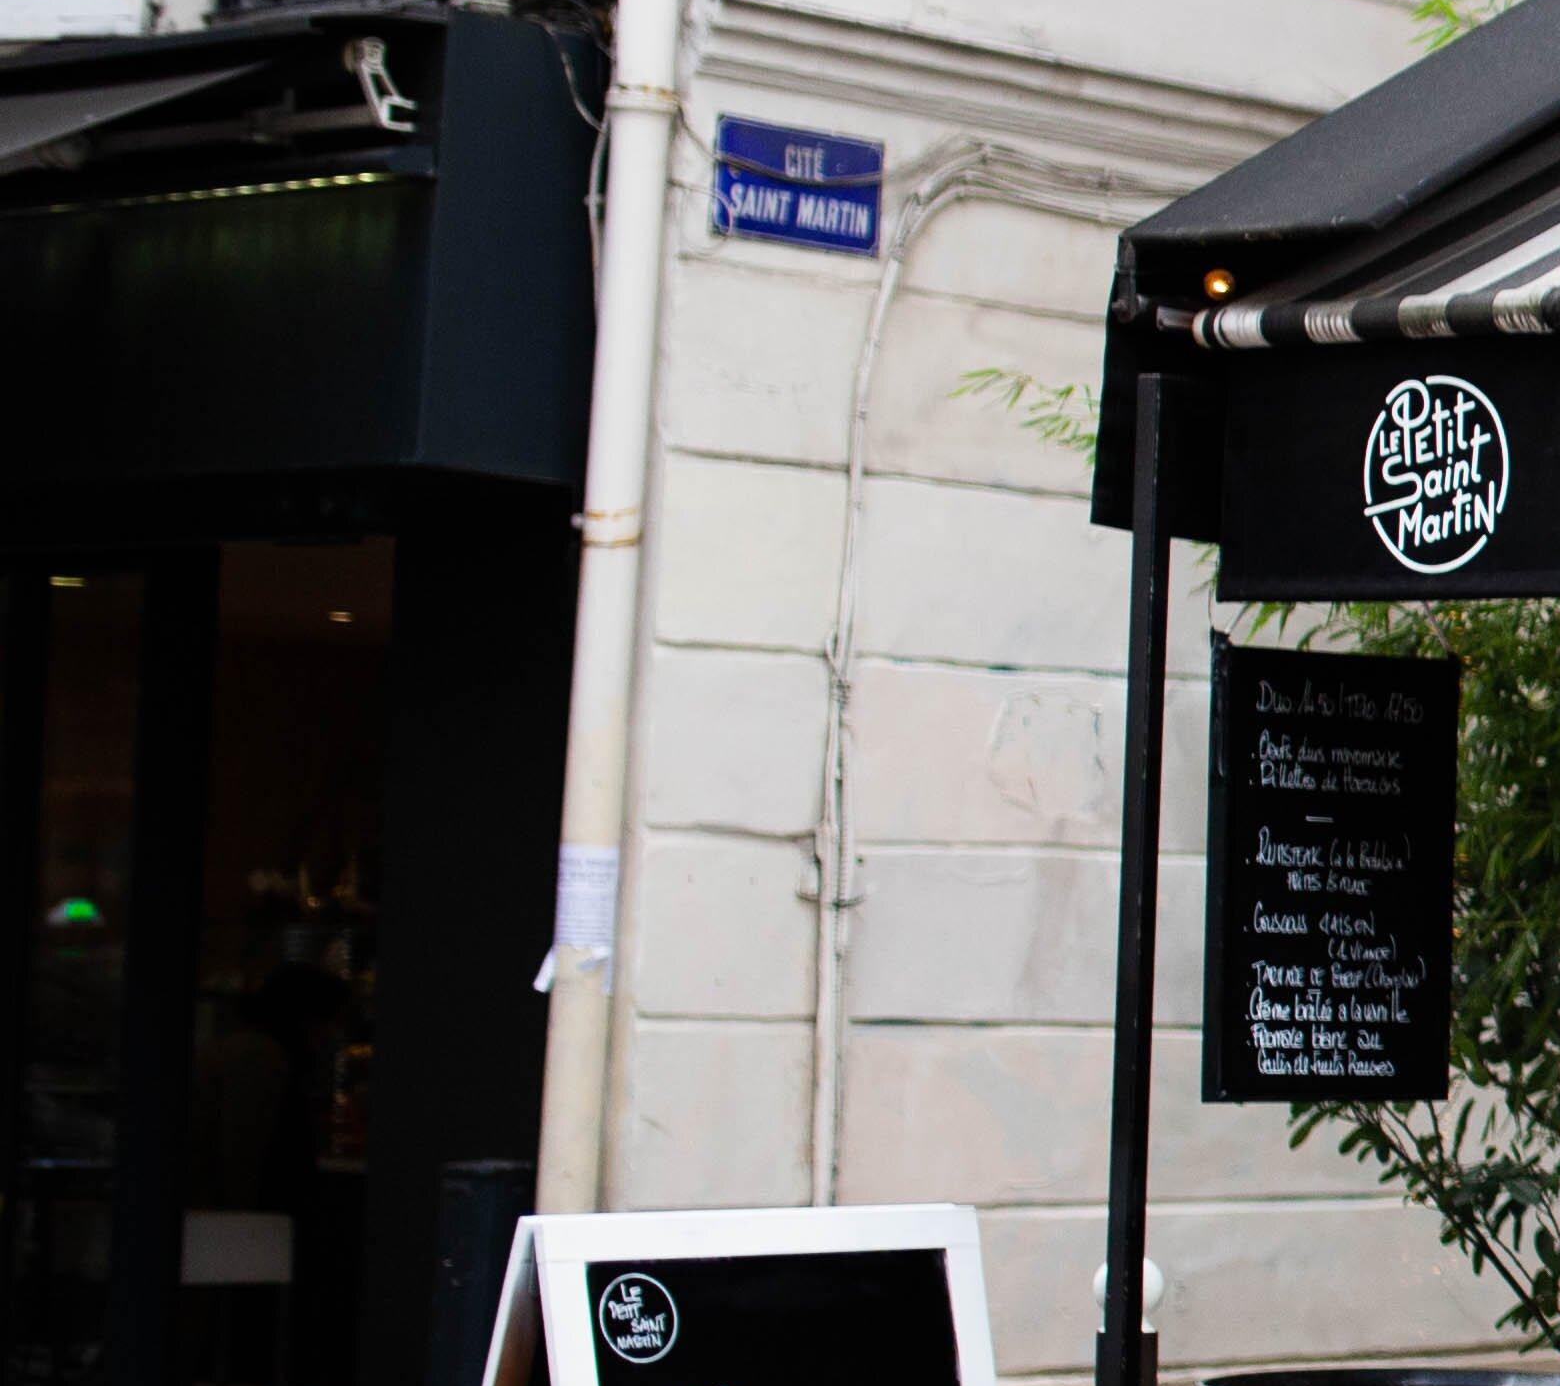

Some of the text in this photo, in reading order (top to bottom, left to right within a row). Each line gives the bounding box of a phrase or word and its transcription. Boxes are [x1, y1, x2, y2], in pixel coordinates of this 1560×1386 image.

[785, 141, 825, 182] CITÉ
[730, 182, 869, 238] SAINT MARTIN
[1364, 423, 1491, 517] Saint
[631, 1313, 667, 1334] SAINT
